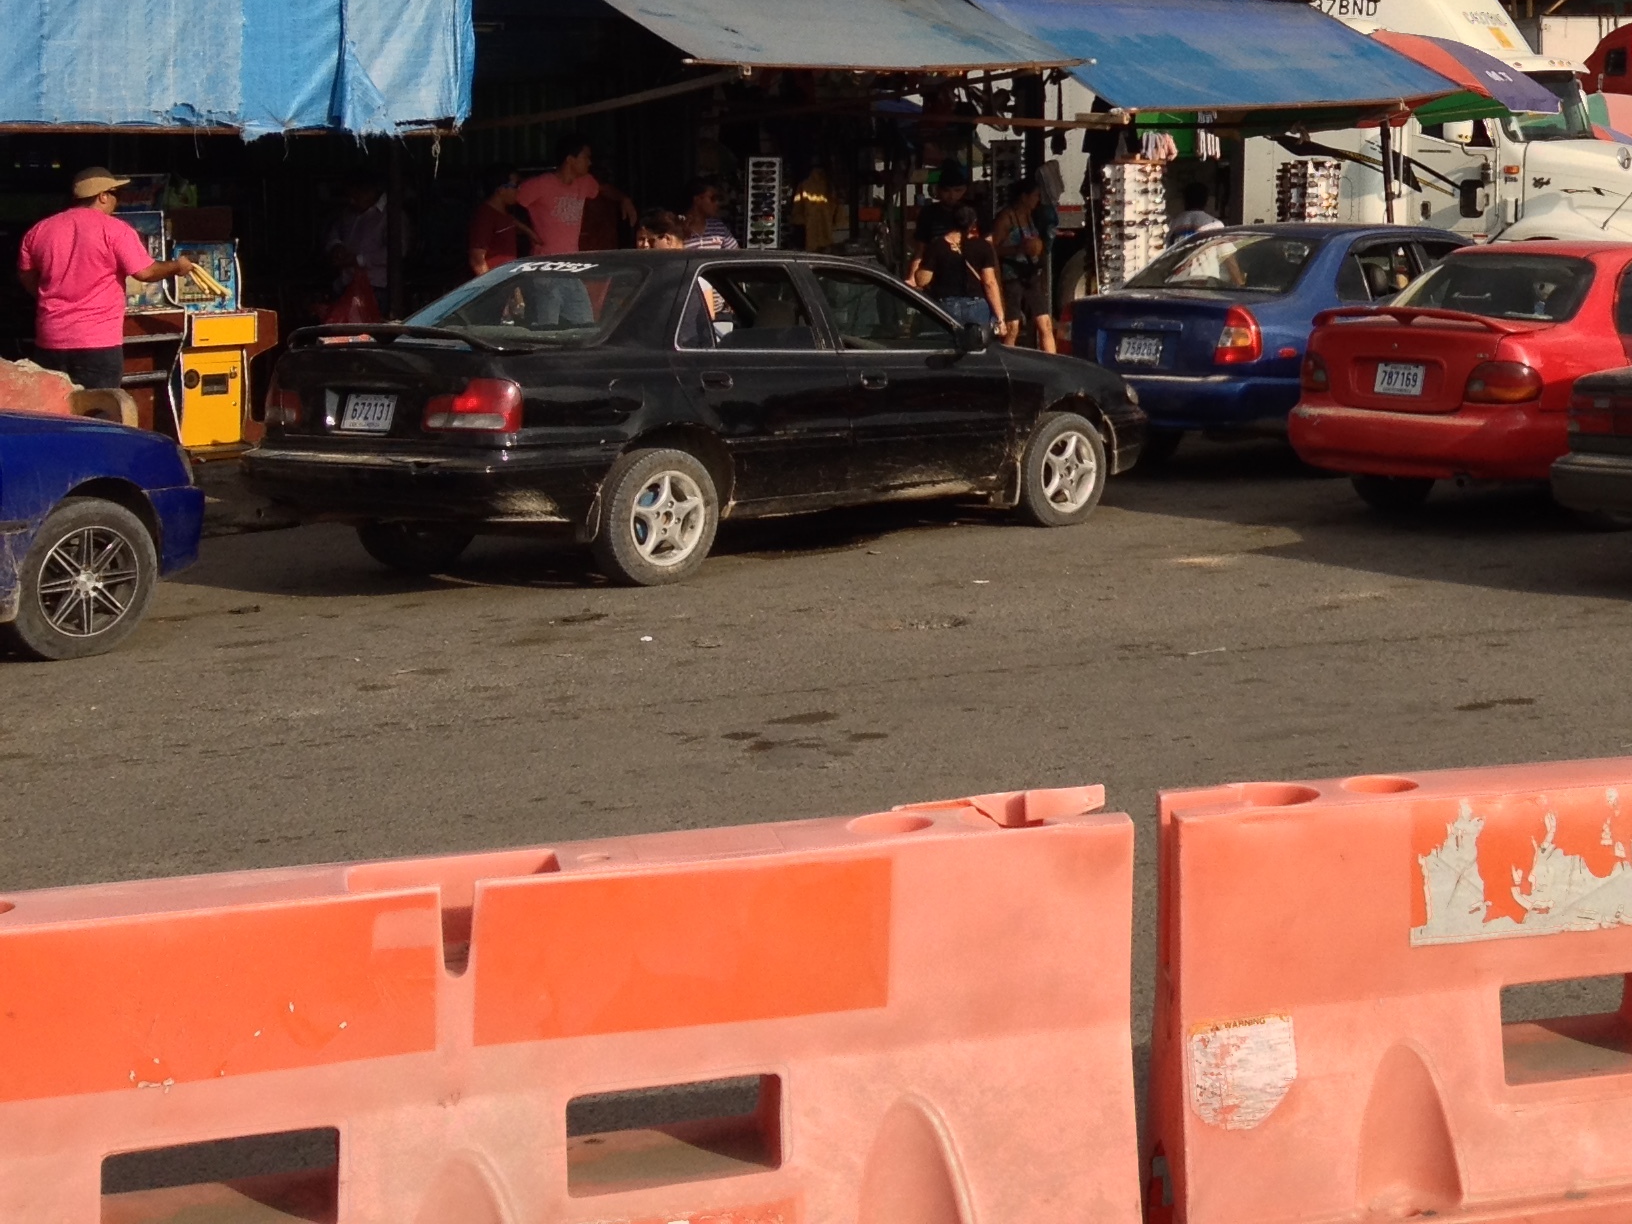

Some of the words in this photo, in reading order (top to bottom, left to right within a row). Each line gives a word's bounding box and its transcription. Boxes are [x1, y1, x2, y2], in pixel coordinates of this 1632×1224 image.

[1380, 370, 1418, 388] 787169
[351, 401, 391, 421] 672131
[1224, 1016, 1266, 1030] WARNING
